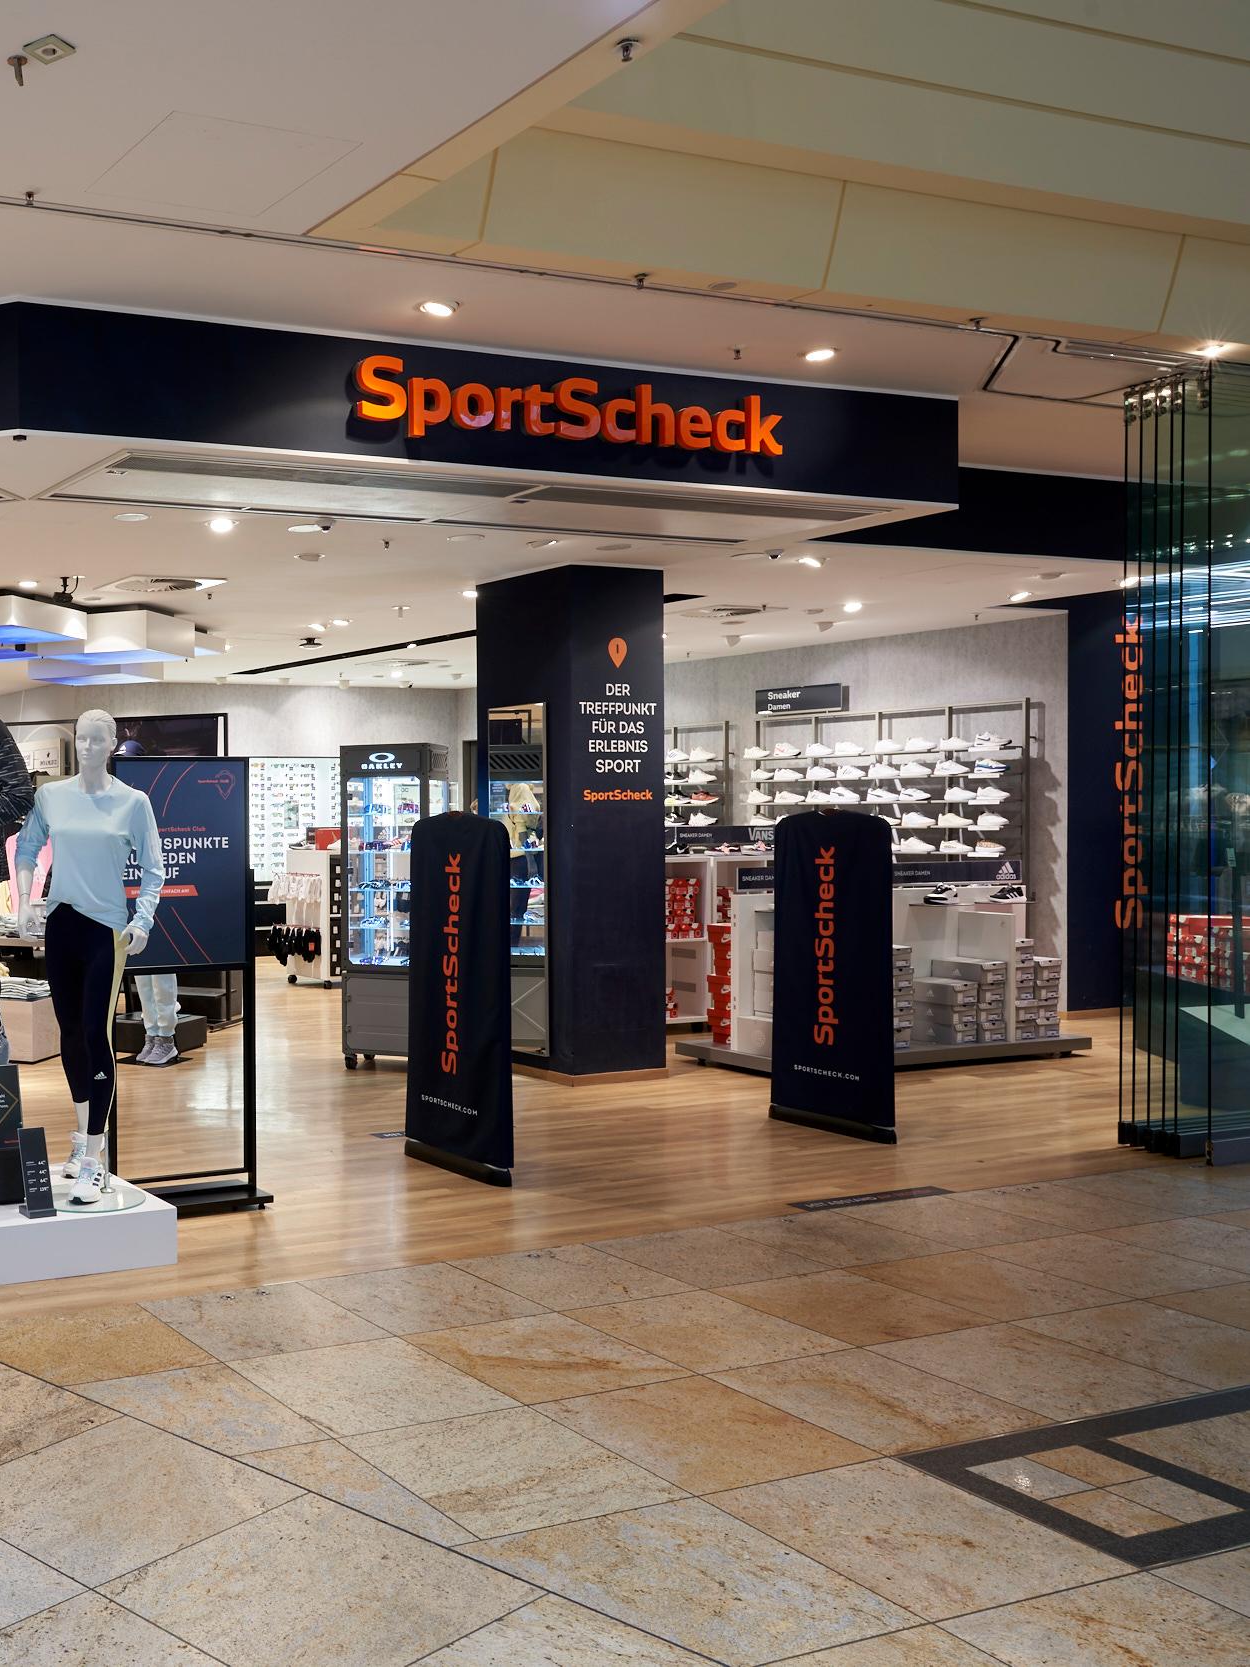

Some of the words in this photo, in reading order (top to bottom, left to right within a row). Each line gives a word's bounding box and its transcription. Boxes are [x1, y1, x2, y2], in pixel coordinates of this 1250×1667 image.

[356, 354, 784, 457] SportScheck
[605, 683, 631, 697] DER
[767, 690, 801, 701] Sneaker
[578, 701, 658, 716] TREFFPUNKT
[767, 703, 791, 711] Damen
[591, 718, 617, 734] FÜR
[619, 721, 645, 735] DAS
[588, 739, 649, 753] ERLEBNIS
[361, 762, 403, 770] OAKLEY
[595, 759, 642, 774] SPORT
[1114, 614, 1148, 929] SportScheck
[583, 788, 653, 803] SportScheck
[158, 825, 191, 833] portScheck
[748, 827, 775, 841] VANS
[160, 837, 229, 849] SPUNKTE
[162, 852, 196, 864] EDEN
[813, 846, 838, 1046] SportScheck
[441, 853, 461, 1075] SportScheck
[793, 1064, 860, 1082] SPORTSCHECK.COM
[421, 1093, 478, 1117] SPORTSCHECK.COM
